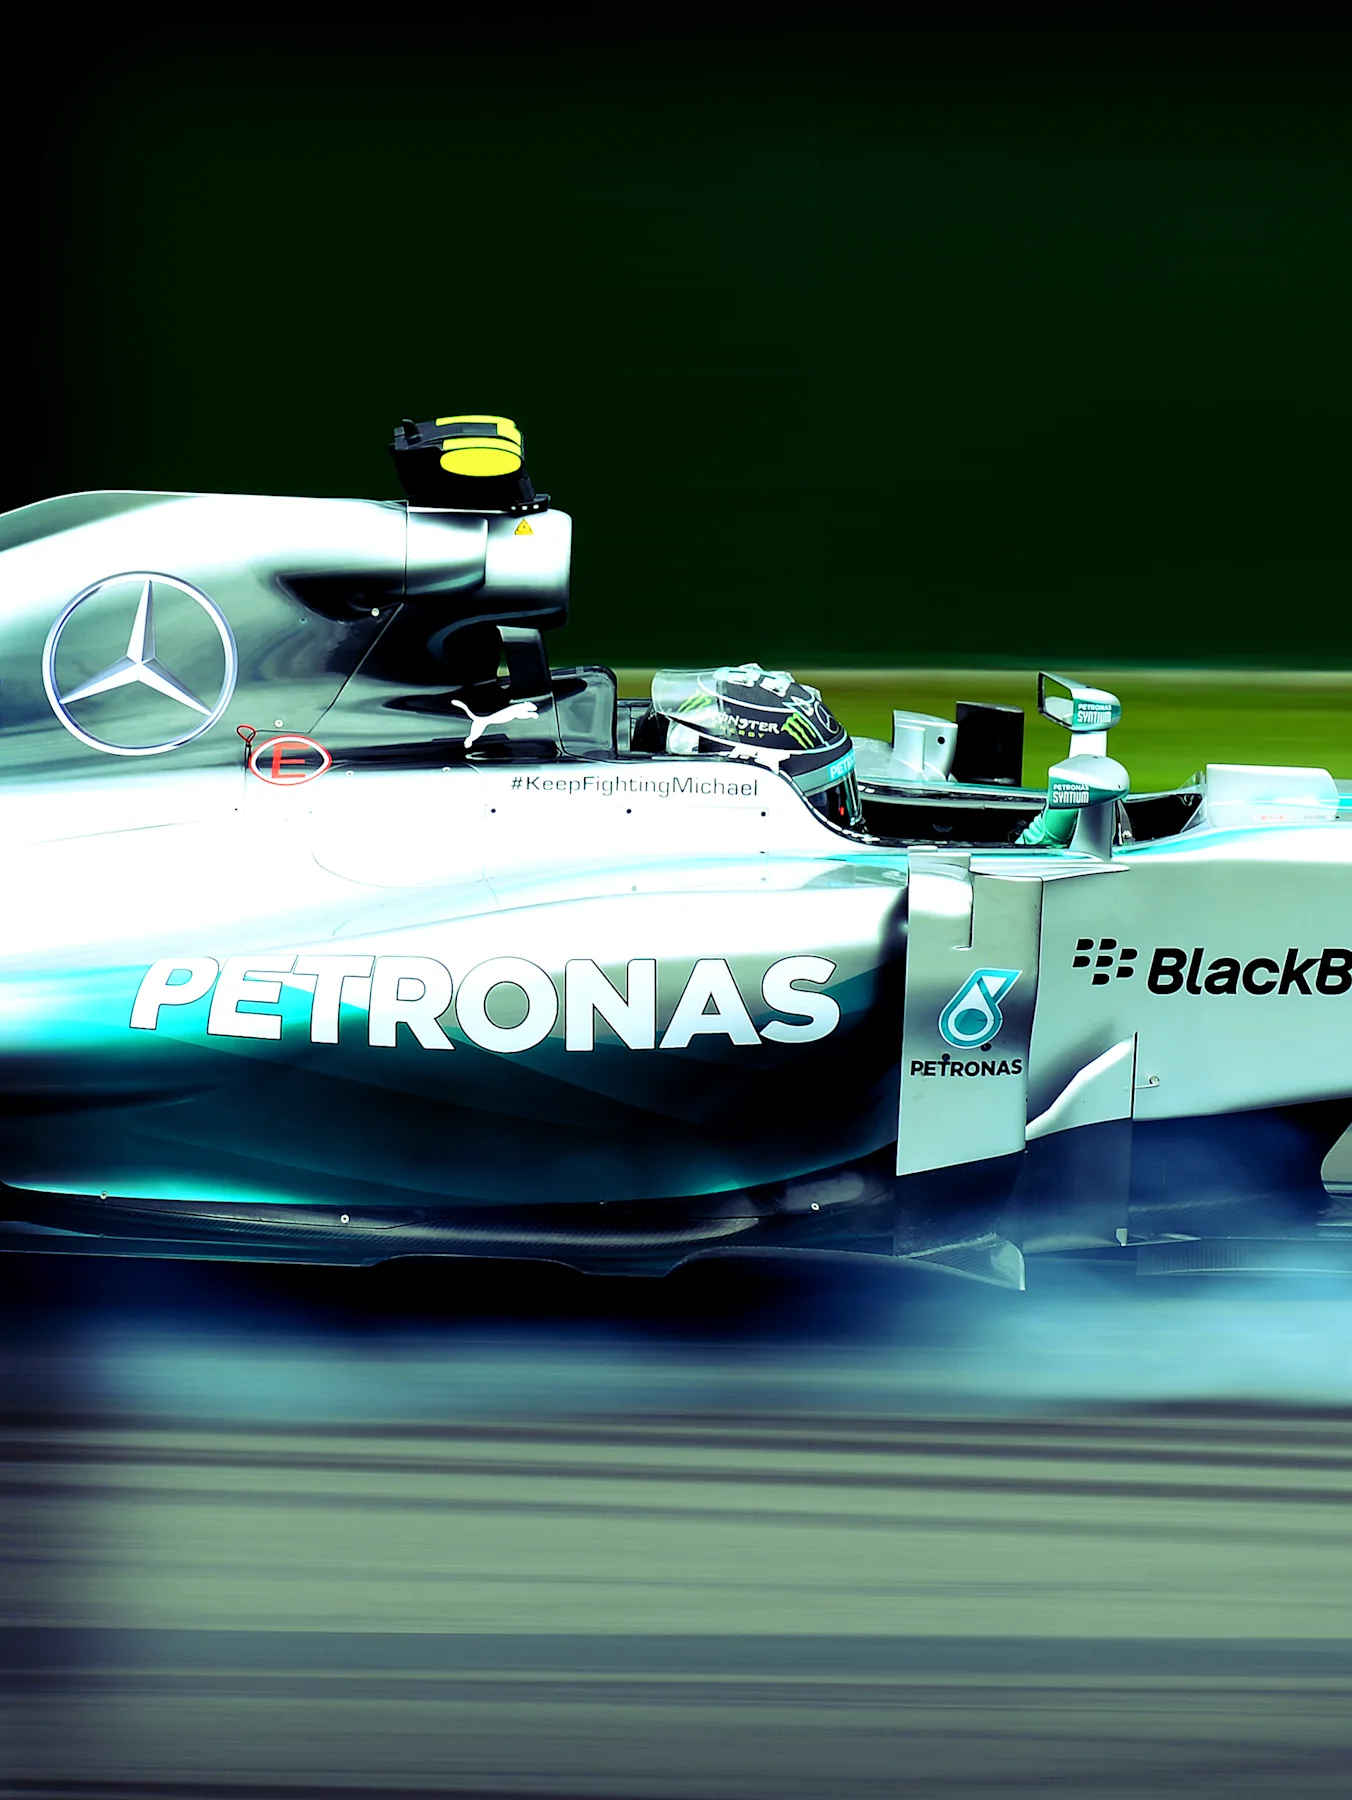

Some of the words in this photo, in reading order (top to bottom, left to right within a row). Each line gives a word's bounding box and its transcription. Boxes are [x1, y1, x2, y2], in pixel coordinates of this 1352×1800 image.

[1078, 703, 1112, 711] PETRONAS
[714, 712, 780, 734] ONSTER
[1077, 711, 1112, 723] SYNTIUM
[271, 742, 309, 779] E
[511, 776, 758, 797] #KeepFightingMichael
[1053, 784, 1090, 792] PETRONAS
[1052, 791, 1090, 804] SYNTIUM
[129, 955, 841, 1053] PETRONAS
[910, 1059, 1023, 1077] PETRONAS
